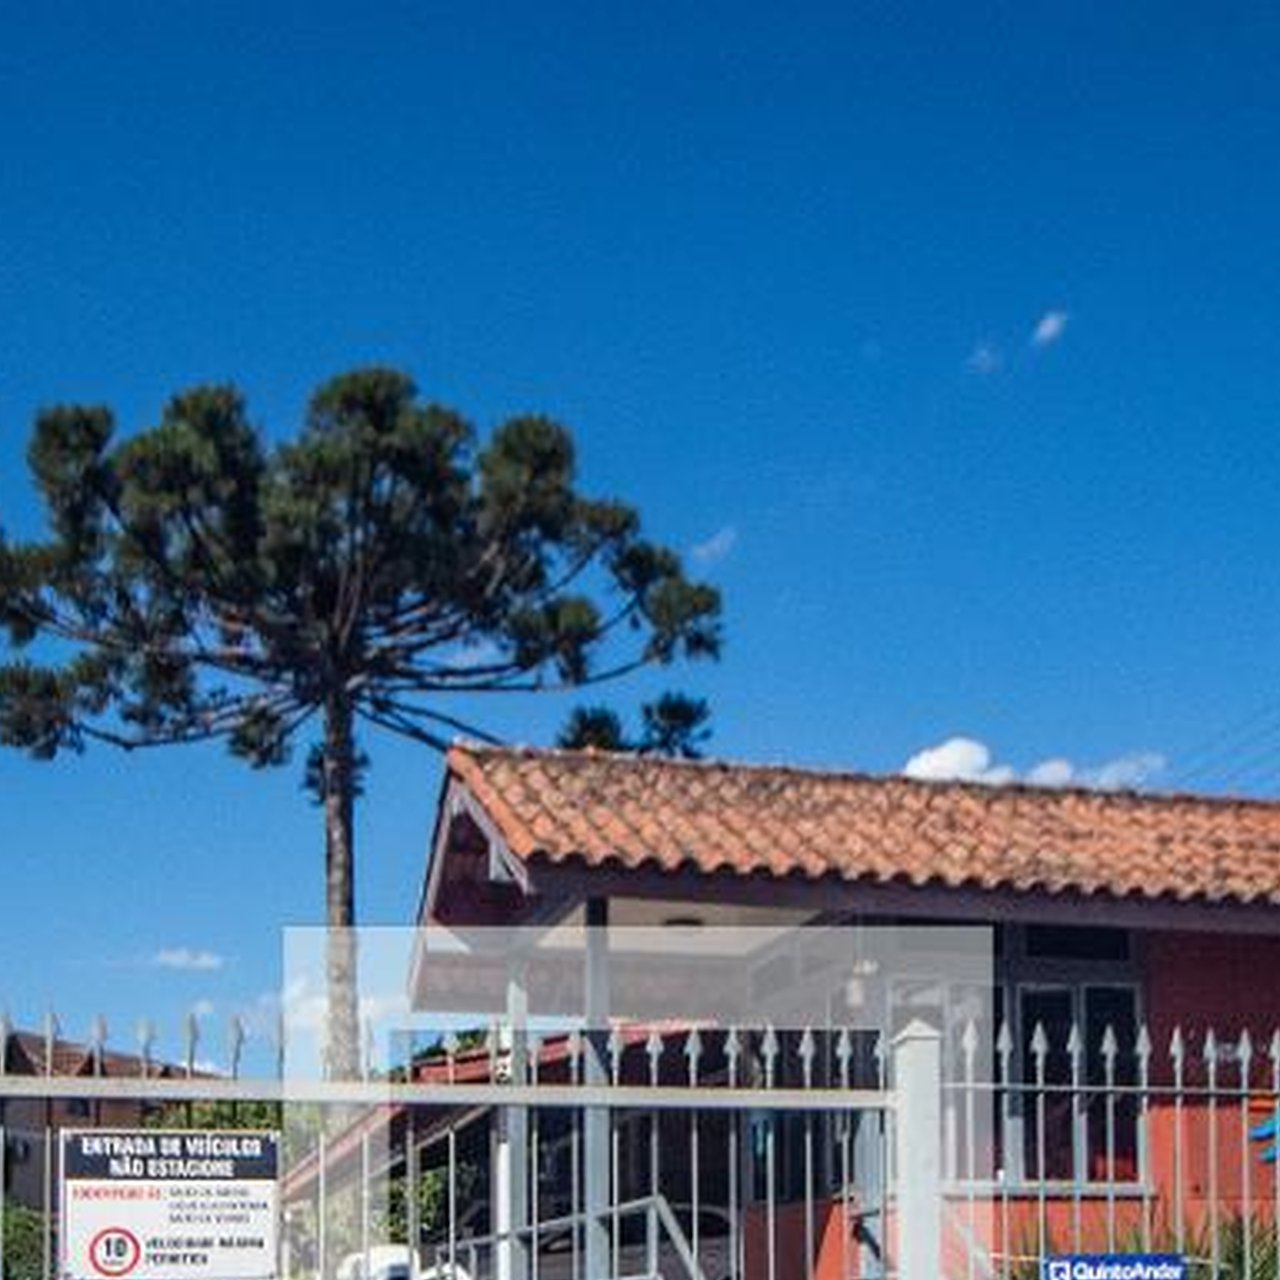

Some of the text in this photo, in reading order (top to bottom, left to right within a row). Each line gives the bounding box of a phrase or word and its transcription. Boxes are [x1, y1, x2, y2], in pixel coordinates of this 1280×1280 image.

[81, 1137, 156, 1155] ENTRADA
[160, 1137, 180, 1156] DE
[109, 1157, 235, 1177] NÃO ESTACIONE
[104, 1237, 128, 1257] 10
[1073, 1261, 1183, 1280] QuintoAndar
